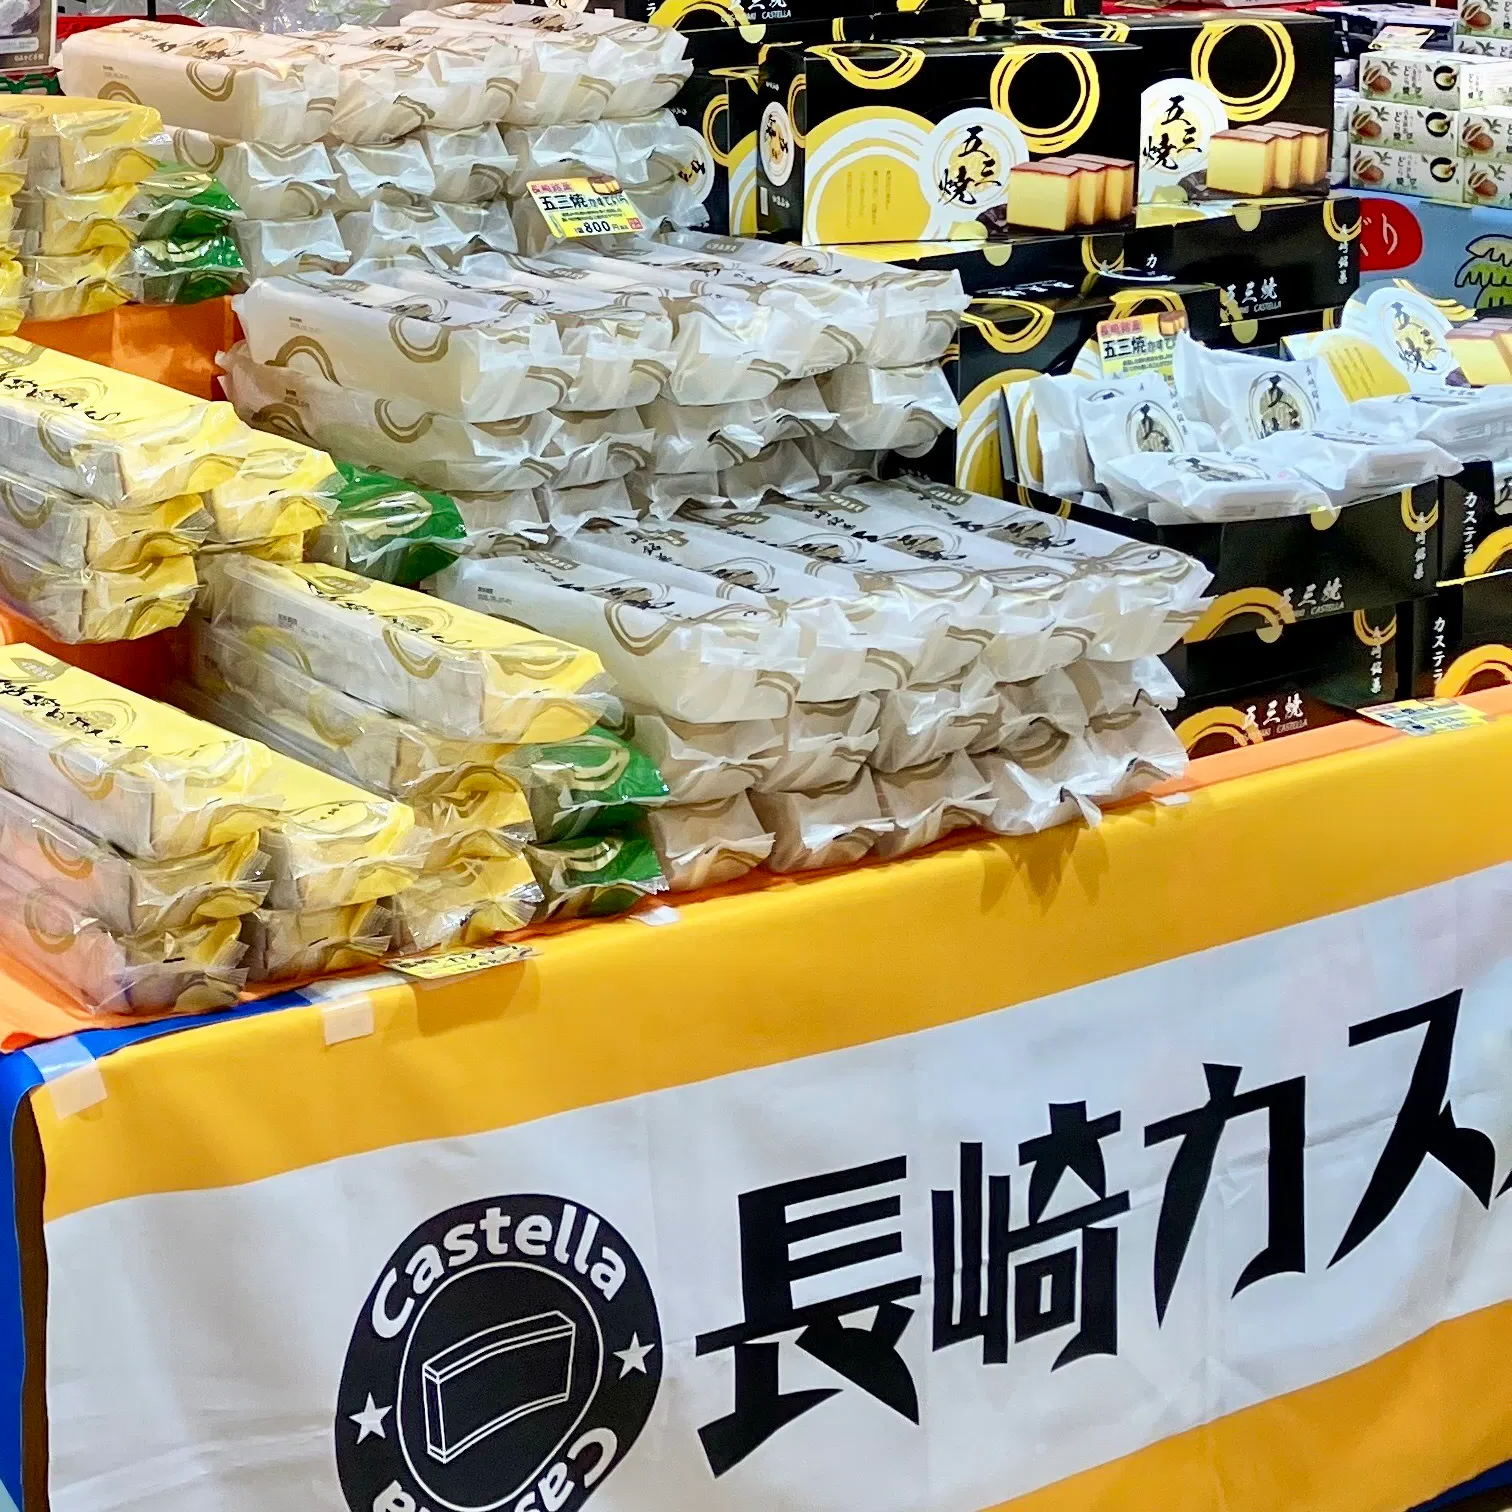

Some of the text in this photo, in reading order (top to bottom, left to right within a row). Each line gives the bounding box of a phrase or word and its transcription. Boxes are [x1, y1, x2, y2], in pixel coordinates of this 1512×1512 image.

[937, 125, 1003, 206] 五三焼
[1142, 95, 1203, 173] 五三焼
[372, 1204, 627, 1339] Castella
[696, 988, 1512, 1478] 長崎カス
